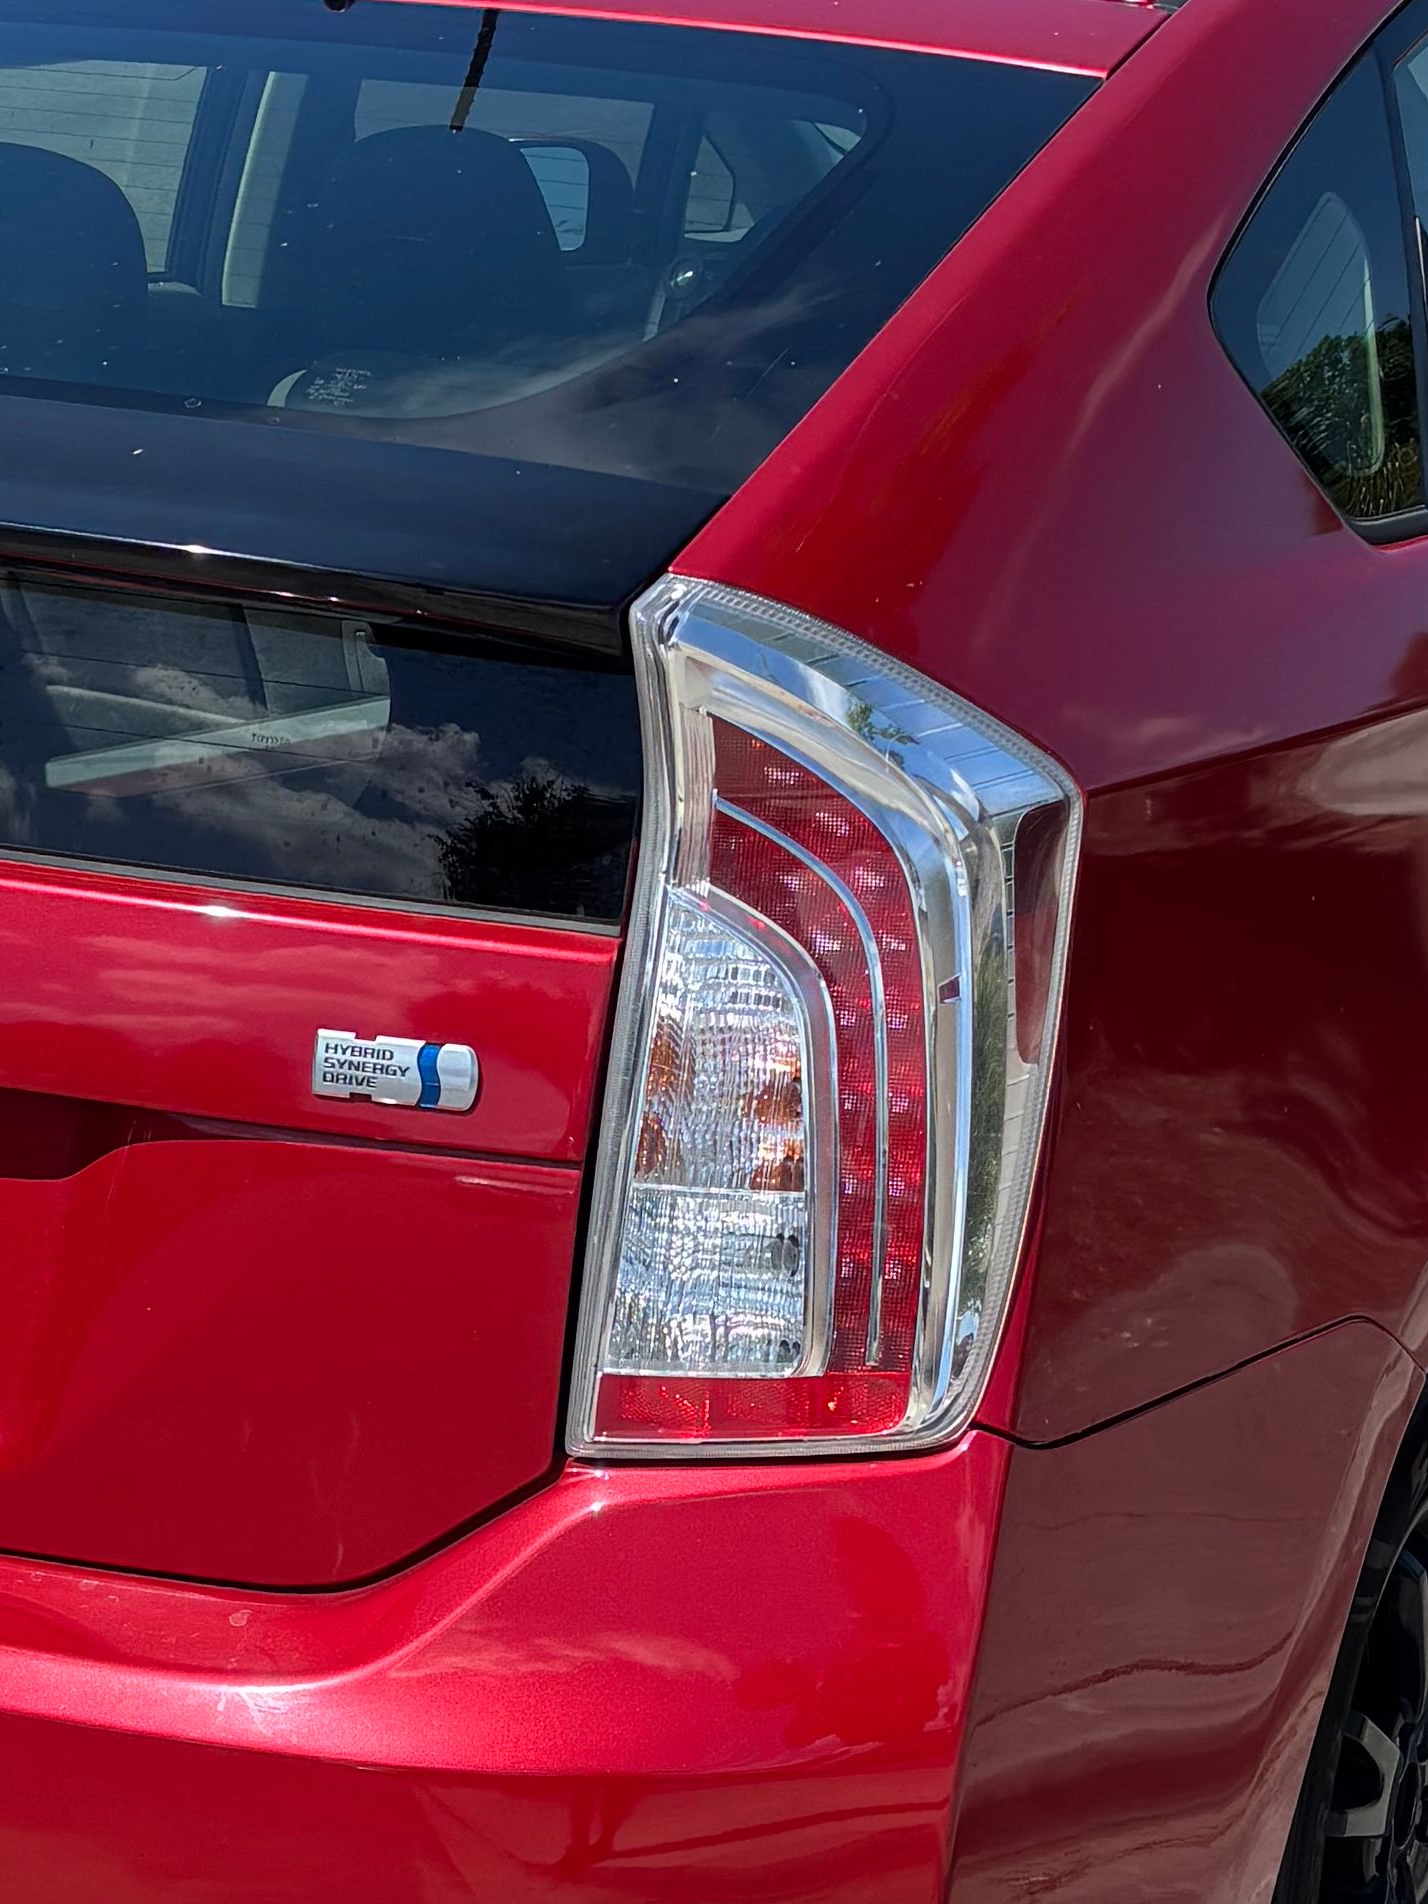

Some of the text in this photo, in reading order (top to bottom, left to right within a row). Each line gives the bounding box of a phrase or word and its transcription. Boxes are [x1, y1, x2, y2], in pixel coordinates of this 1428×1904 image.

[324, 1041, 395, 1062] HYBRID
[323, 1056, 411, 1078] SYNERGY
[322, 1069, 378, 1089] DRIVE
